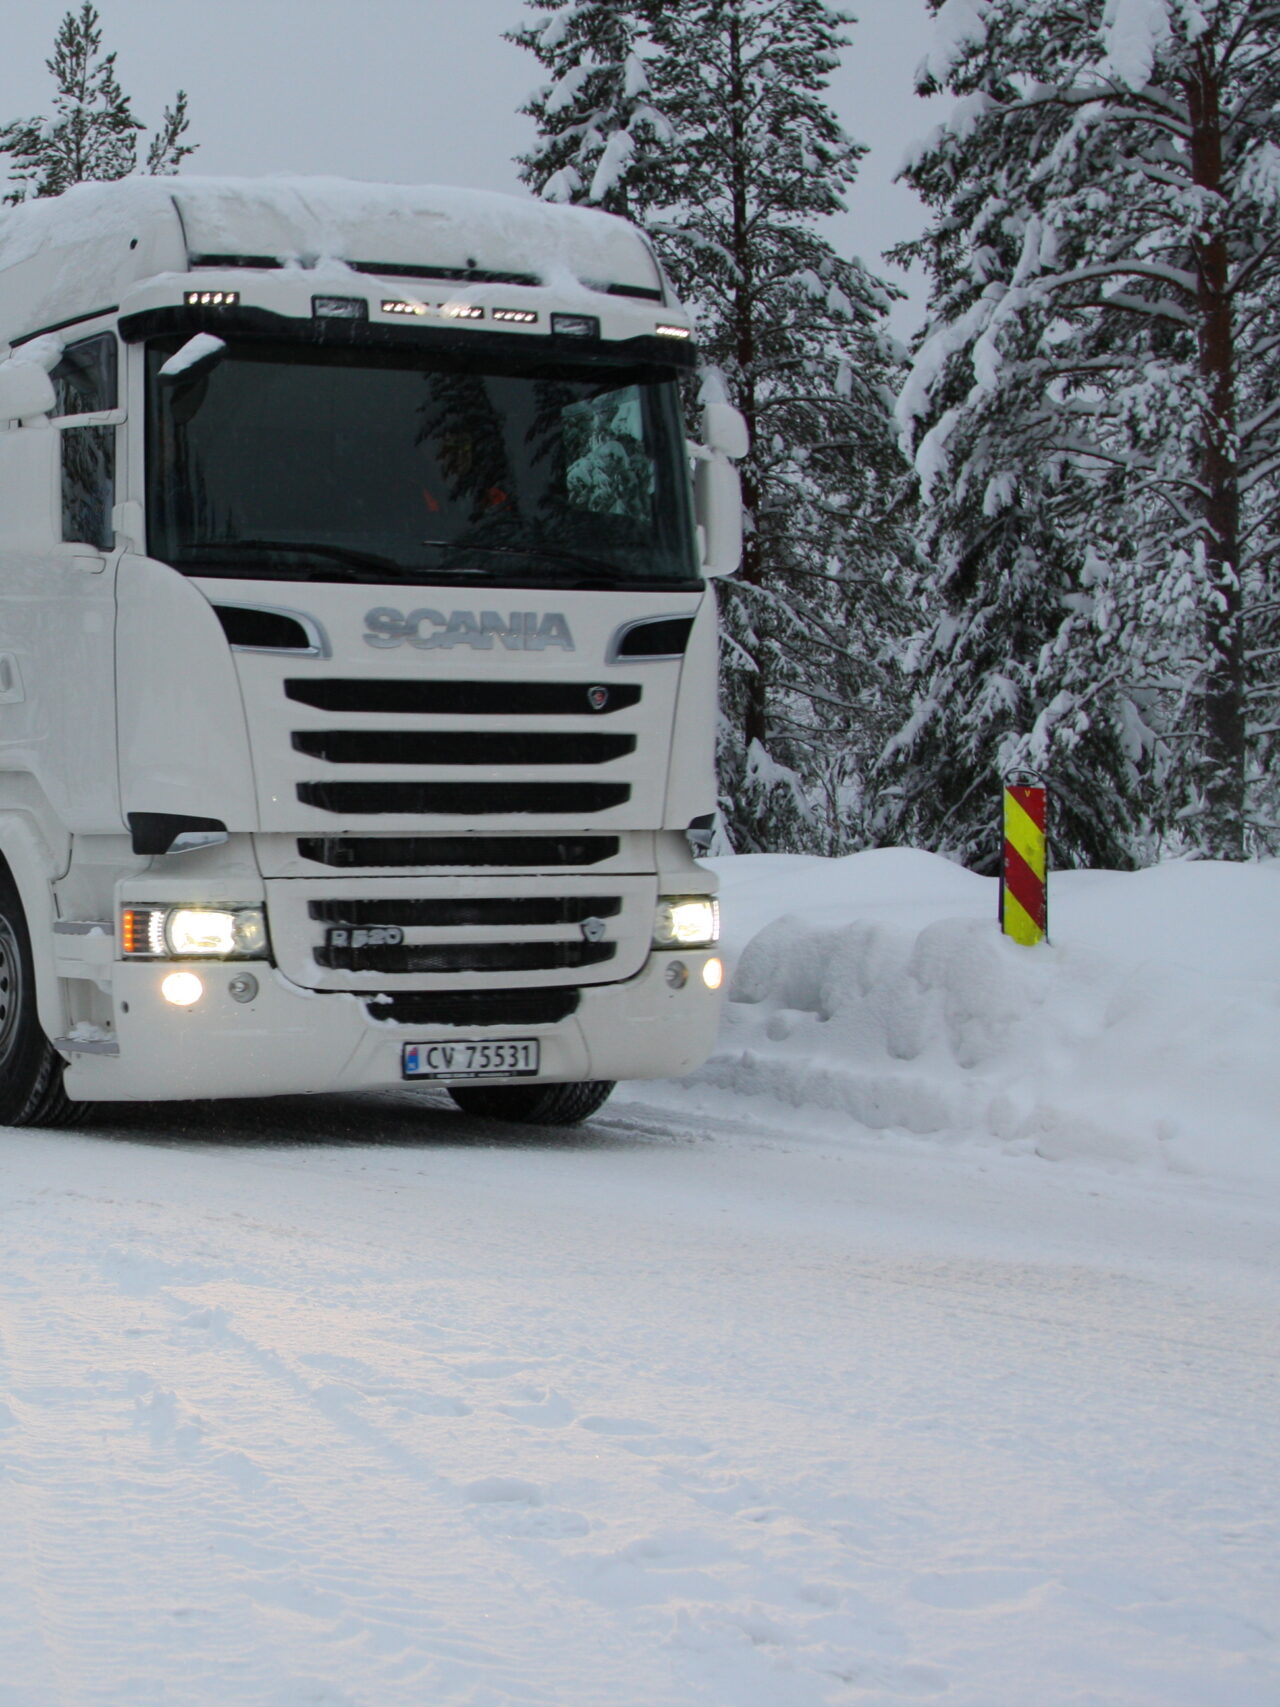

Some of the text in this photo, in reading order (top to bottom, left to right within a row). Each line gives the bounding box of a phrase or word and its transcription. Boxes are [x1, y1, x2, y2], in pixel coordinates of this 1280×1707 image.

[363, 606, 575, 652] SCANIA
[351, 928, 401, 948] 520
[427, 1044, 530, 1069] CV 75531
